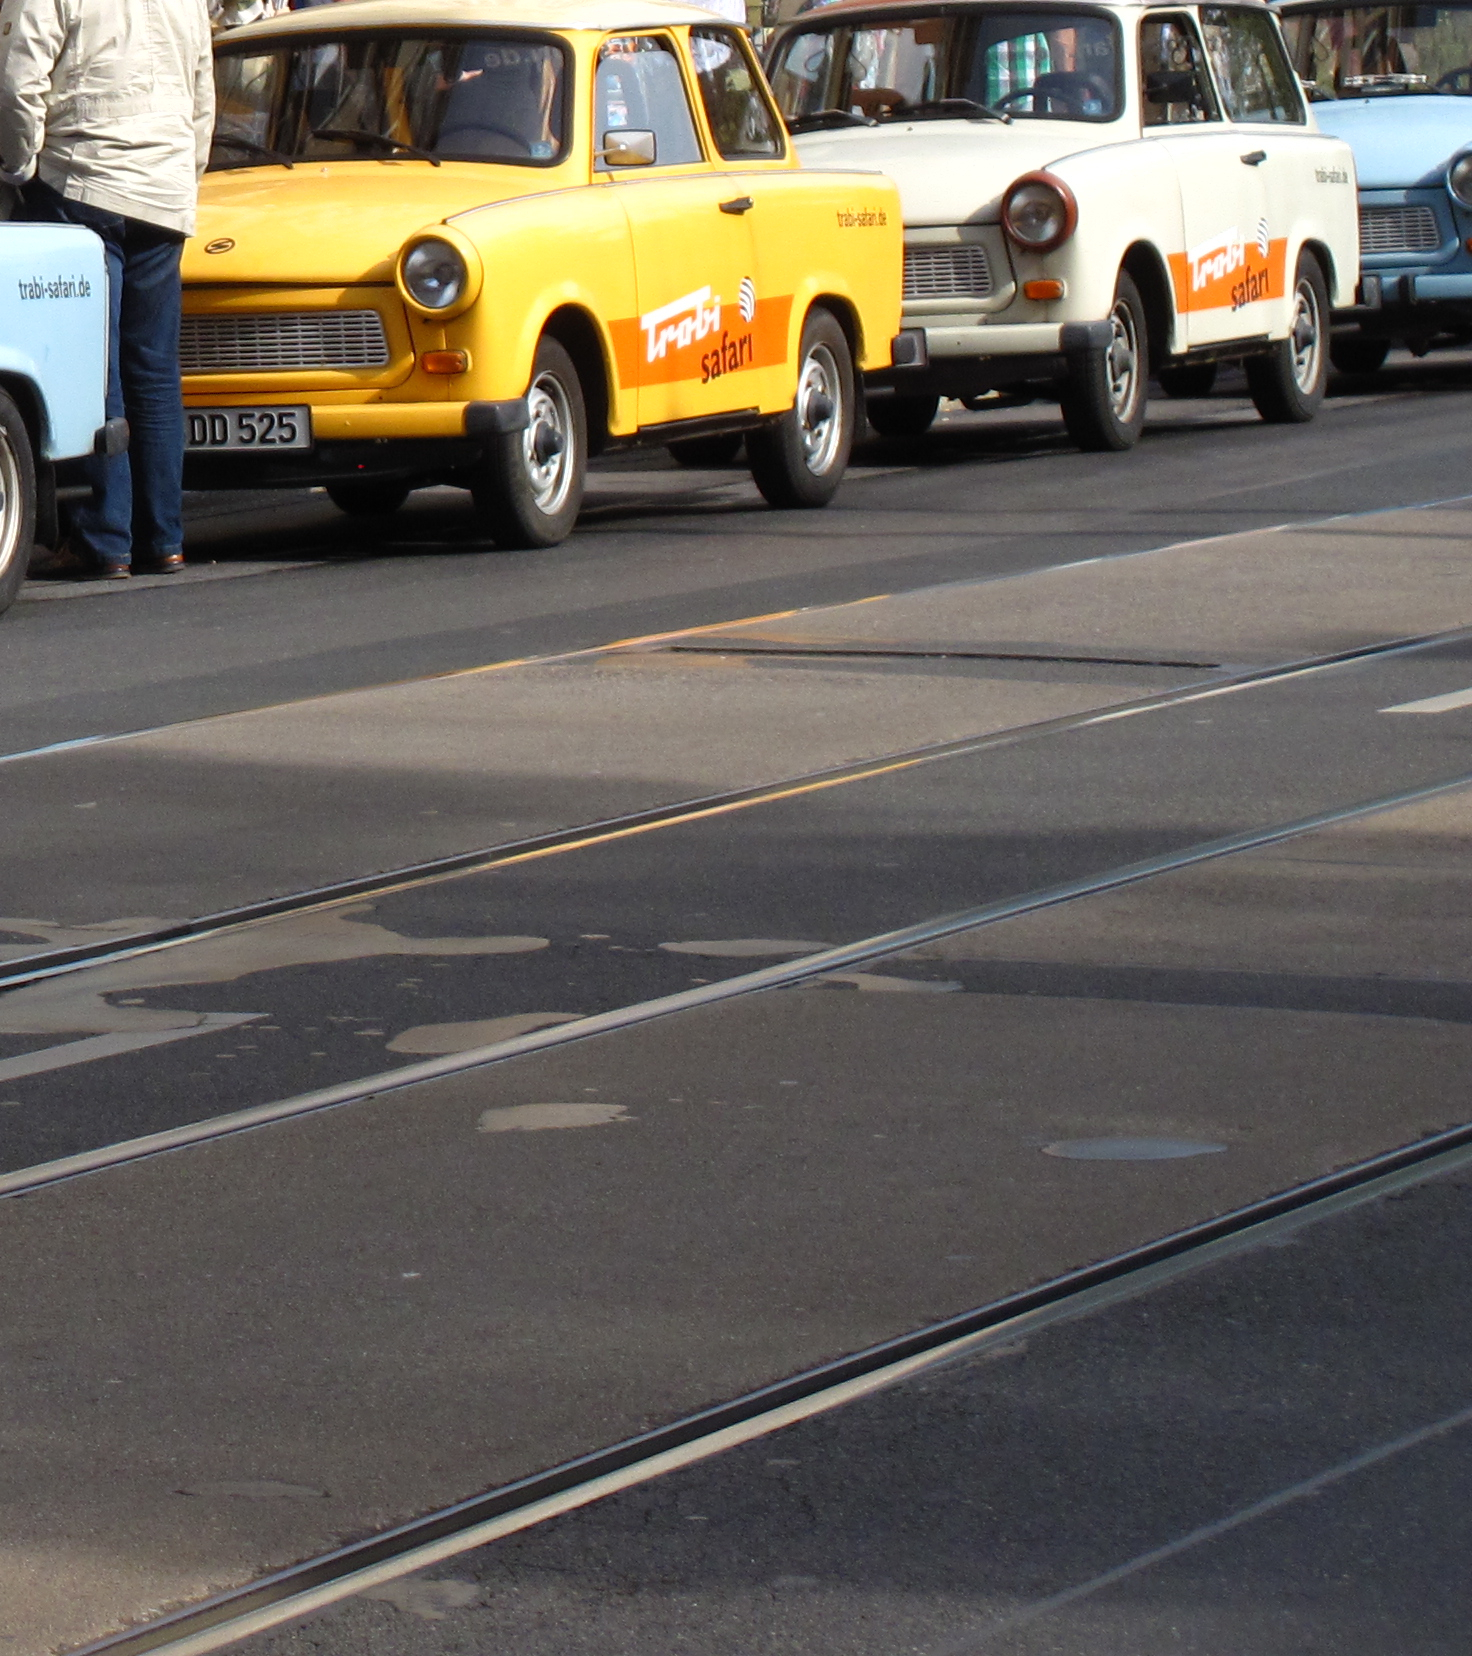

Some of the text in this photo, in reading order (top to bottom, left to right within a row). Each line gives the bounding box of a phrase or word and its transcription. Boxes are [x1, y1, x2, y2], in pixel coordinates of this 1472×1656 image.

[837, 207, 887, 228] trabi-safari.de
[18, 275, 91, 300] trabi-safari.de
[1231, 265, 1270, 313] safari
[701, 331, 753, 384] safari
